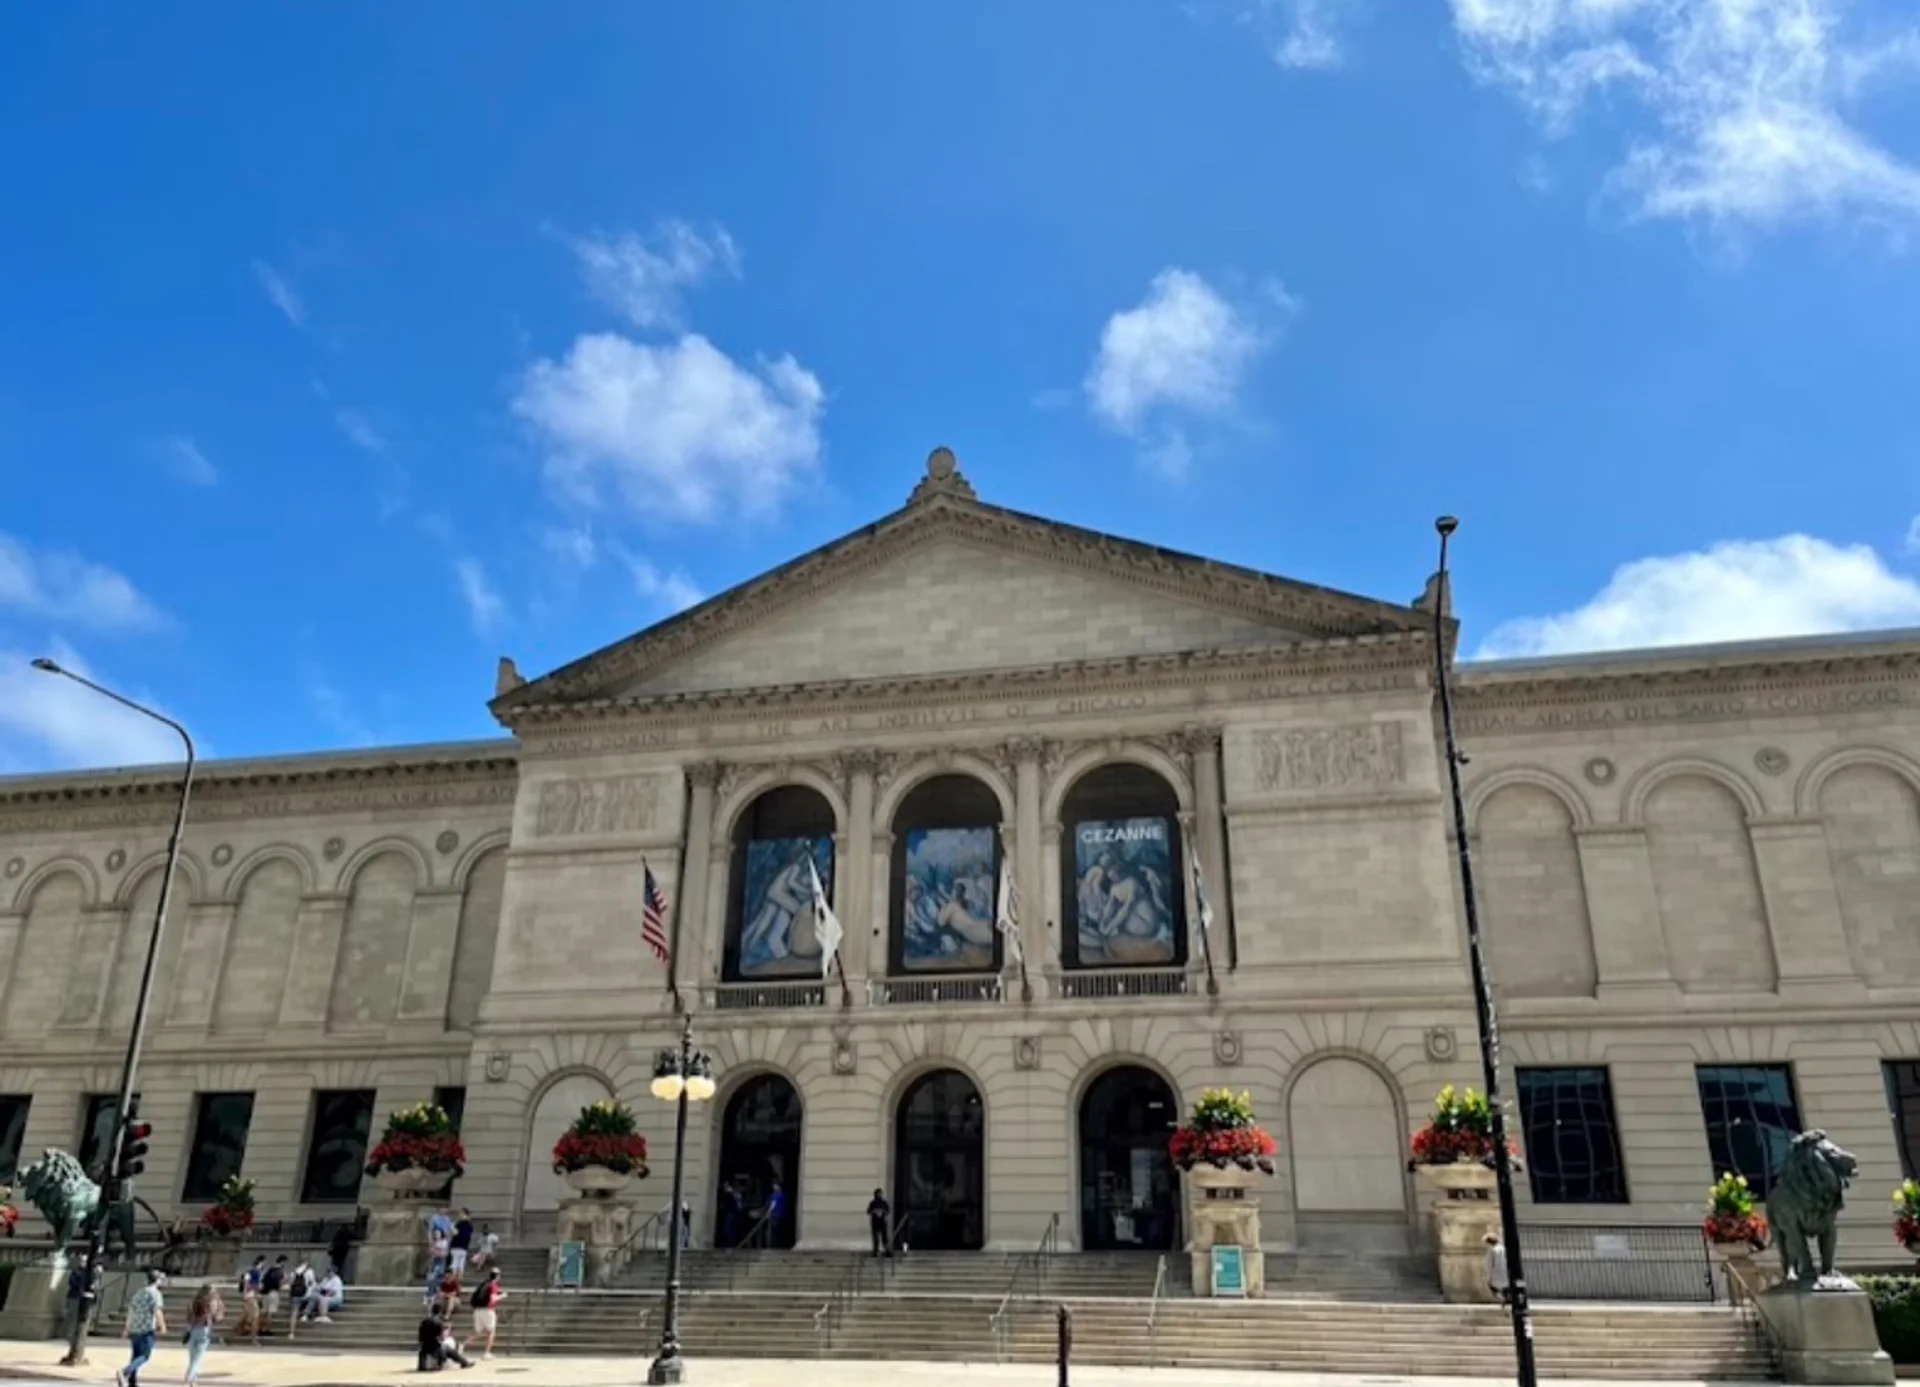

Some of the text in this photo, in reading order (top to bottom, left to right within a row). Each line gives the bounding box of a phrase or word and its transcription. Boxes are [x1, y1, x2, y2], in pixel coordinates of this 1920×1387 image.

[757, 720, 793, 737] THE
[818, 716, 854, 733] ART
[1005, 703, 1031, 719] OF
[1055, 695, 1147, 714] CHICAGO
[1535, 707, 1617, 729] ANDREA
[1623, 703, 1668, 722] DEL
[1674, 699, 1744, 719] SARTO
[1766, 686, 1901, 712] CORREGGIO
[1080, 825, 1164, 844] CEZANNE
